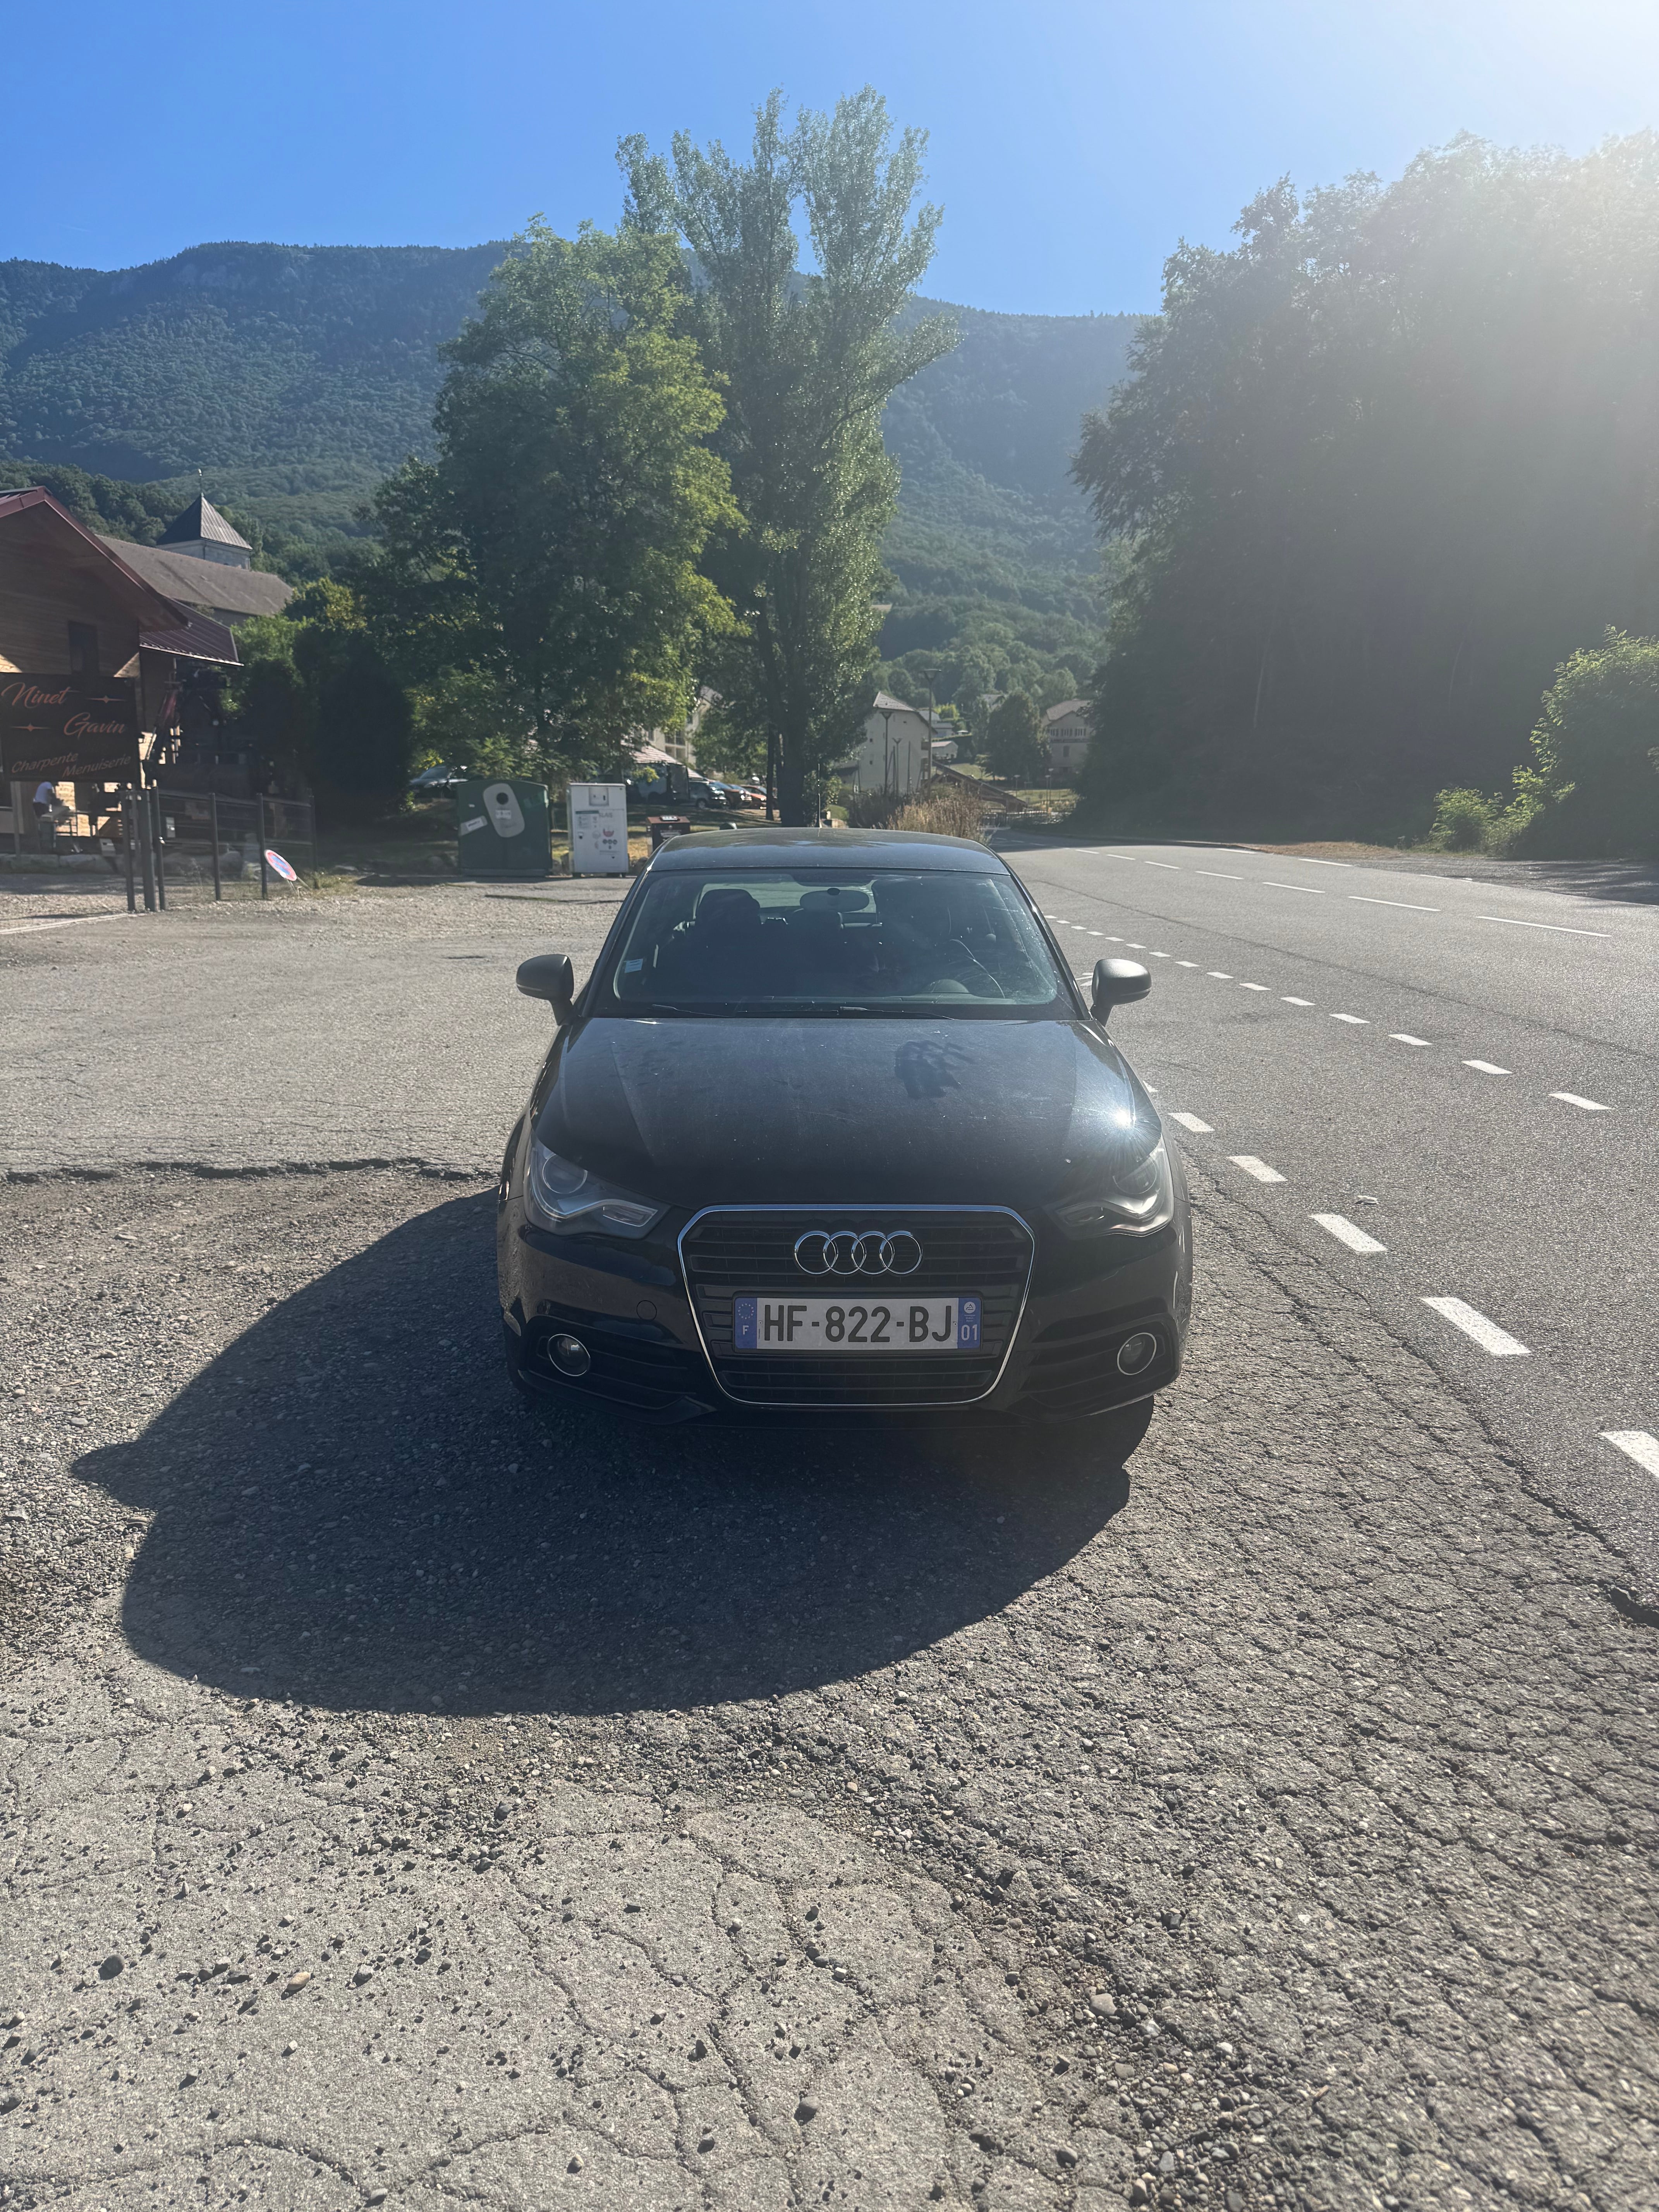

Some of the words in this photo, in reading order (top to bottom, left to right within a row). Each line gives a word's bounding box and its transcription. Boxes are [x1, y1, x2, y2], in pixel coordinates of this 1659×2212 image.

[1, 682, 82, 708] Ninet
[63, 712, 125, 739] Gavin
[11, 752, 78, 773] Charpente
[62, 754, 131, 778] Menuiserie
[742, 1325, 749, 1335] F
[764, 1304, 951, 1342] HF-822-BJ
[961, 1324, 977, 1340] 01
